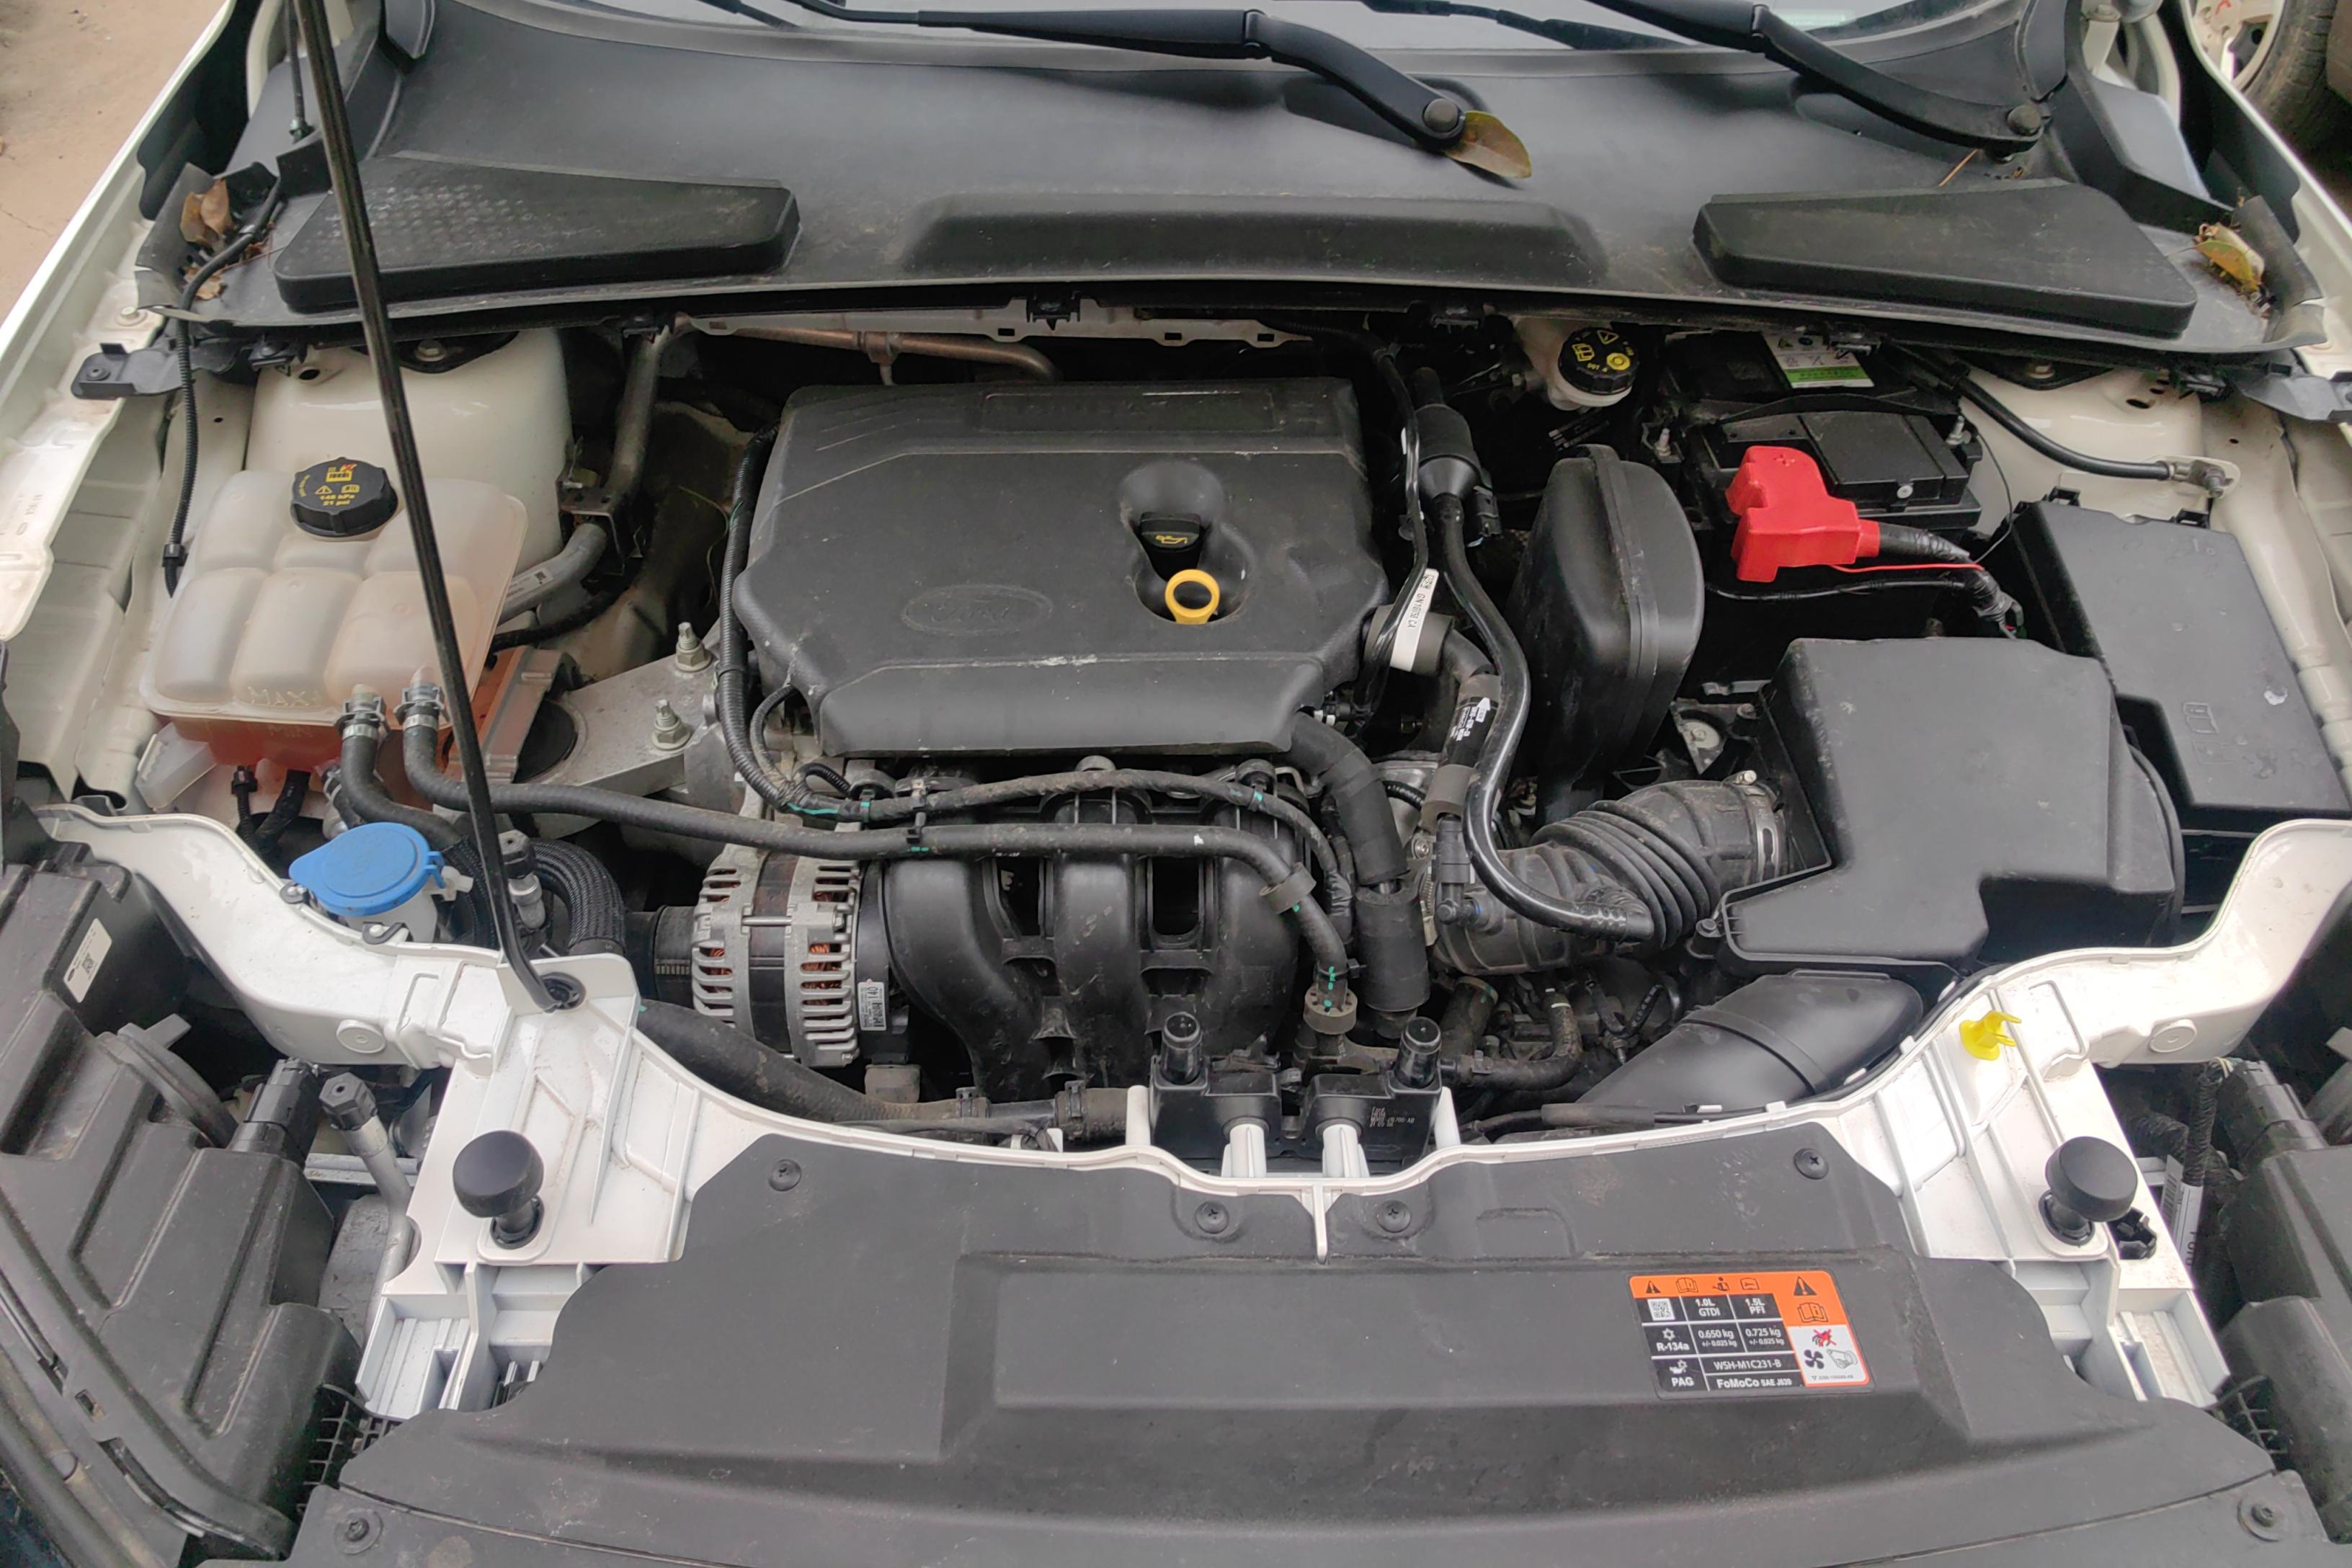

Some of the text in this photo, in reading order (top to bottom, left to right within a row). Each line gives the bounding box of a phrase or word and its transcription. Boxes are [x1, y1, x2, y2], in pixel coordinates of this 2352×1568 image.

[247, 685, 310, 706] MAX
[866, 986, 879, 999] 140
[1696, 1298, 1715, 1307] 1.0L
[1745, 1298, 1765, 1306] 1.5L
[1698, 1307, 1721, 1317] GTDI
[1749, 1306, 1765, 1315] PFI
[1698, 1329, 1734, 1340] 0.650 kg
[1745, 1327, 1782, 1338] 0.725 kg
[1656, 1342, 1690, 1352] R-134a
[1728, 1340, 1737, 1348] kg
[1775, 1337, 1785, 1347] kg
[1714, 1359, 1782, 1371] WSH-M1C231-B
[1671, 1376, 1693, 1387] PAG
[1716, 1376, 1760, 1389] FoMoCo
[1760, 1378, 1776, 1387] SAE
